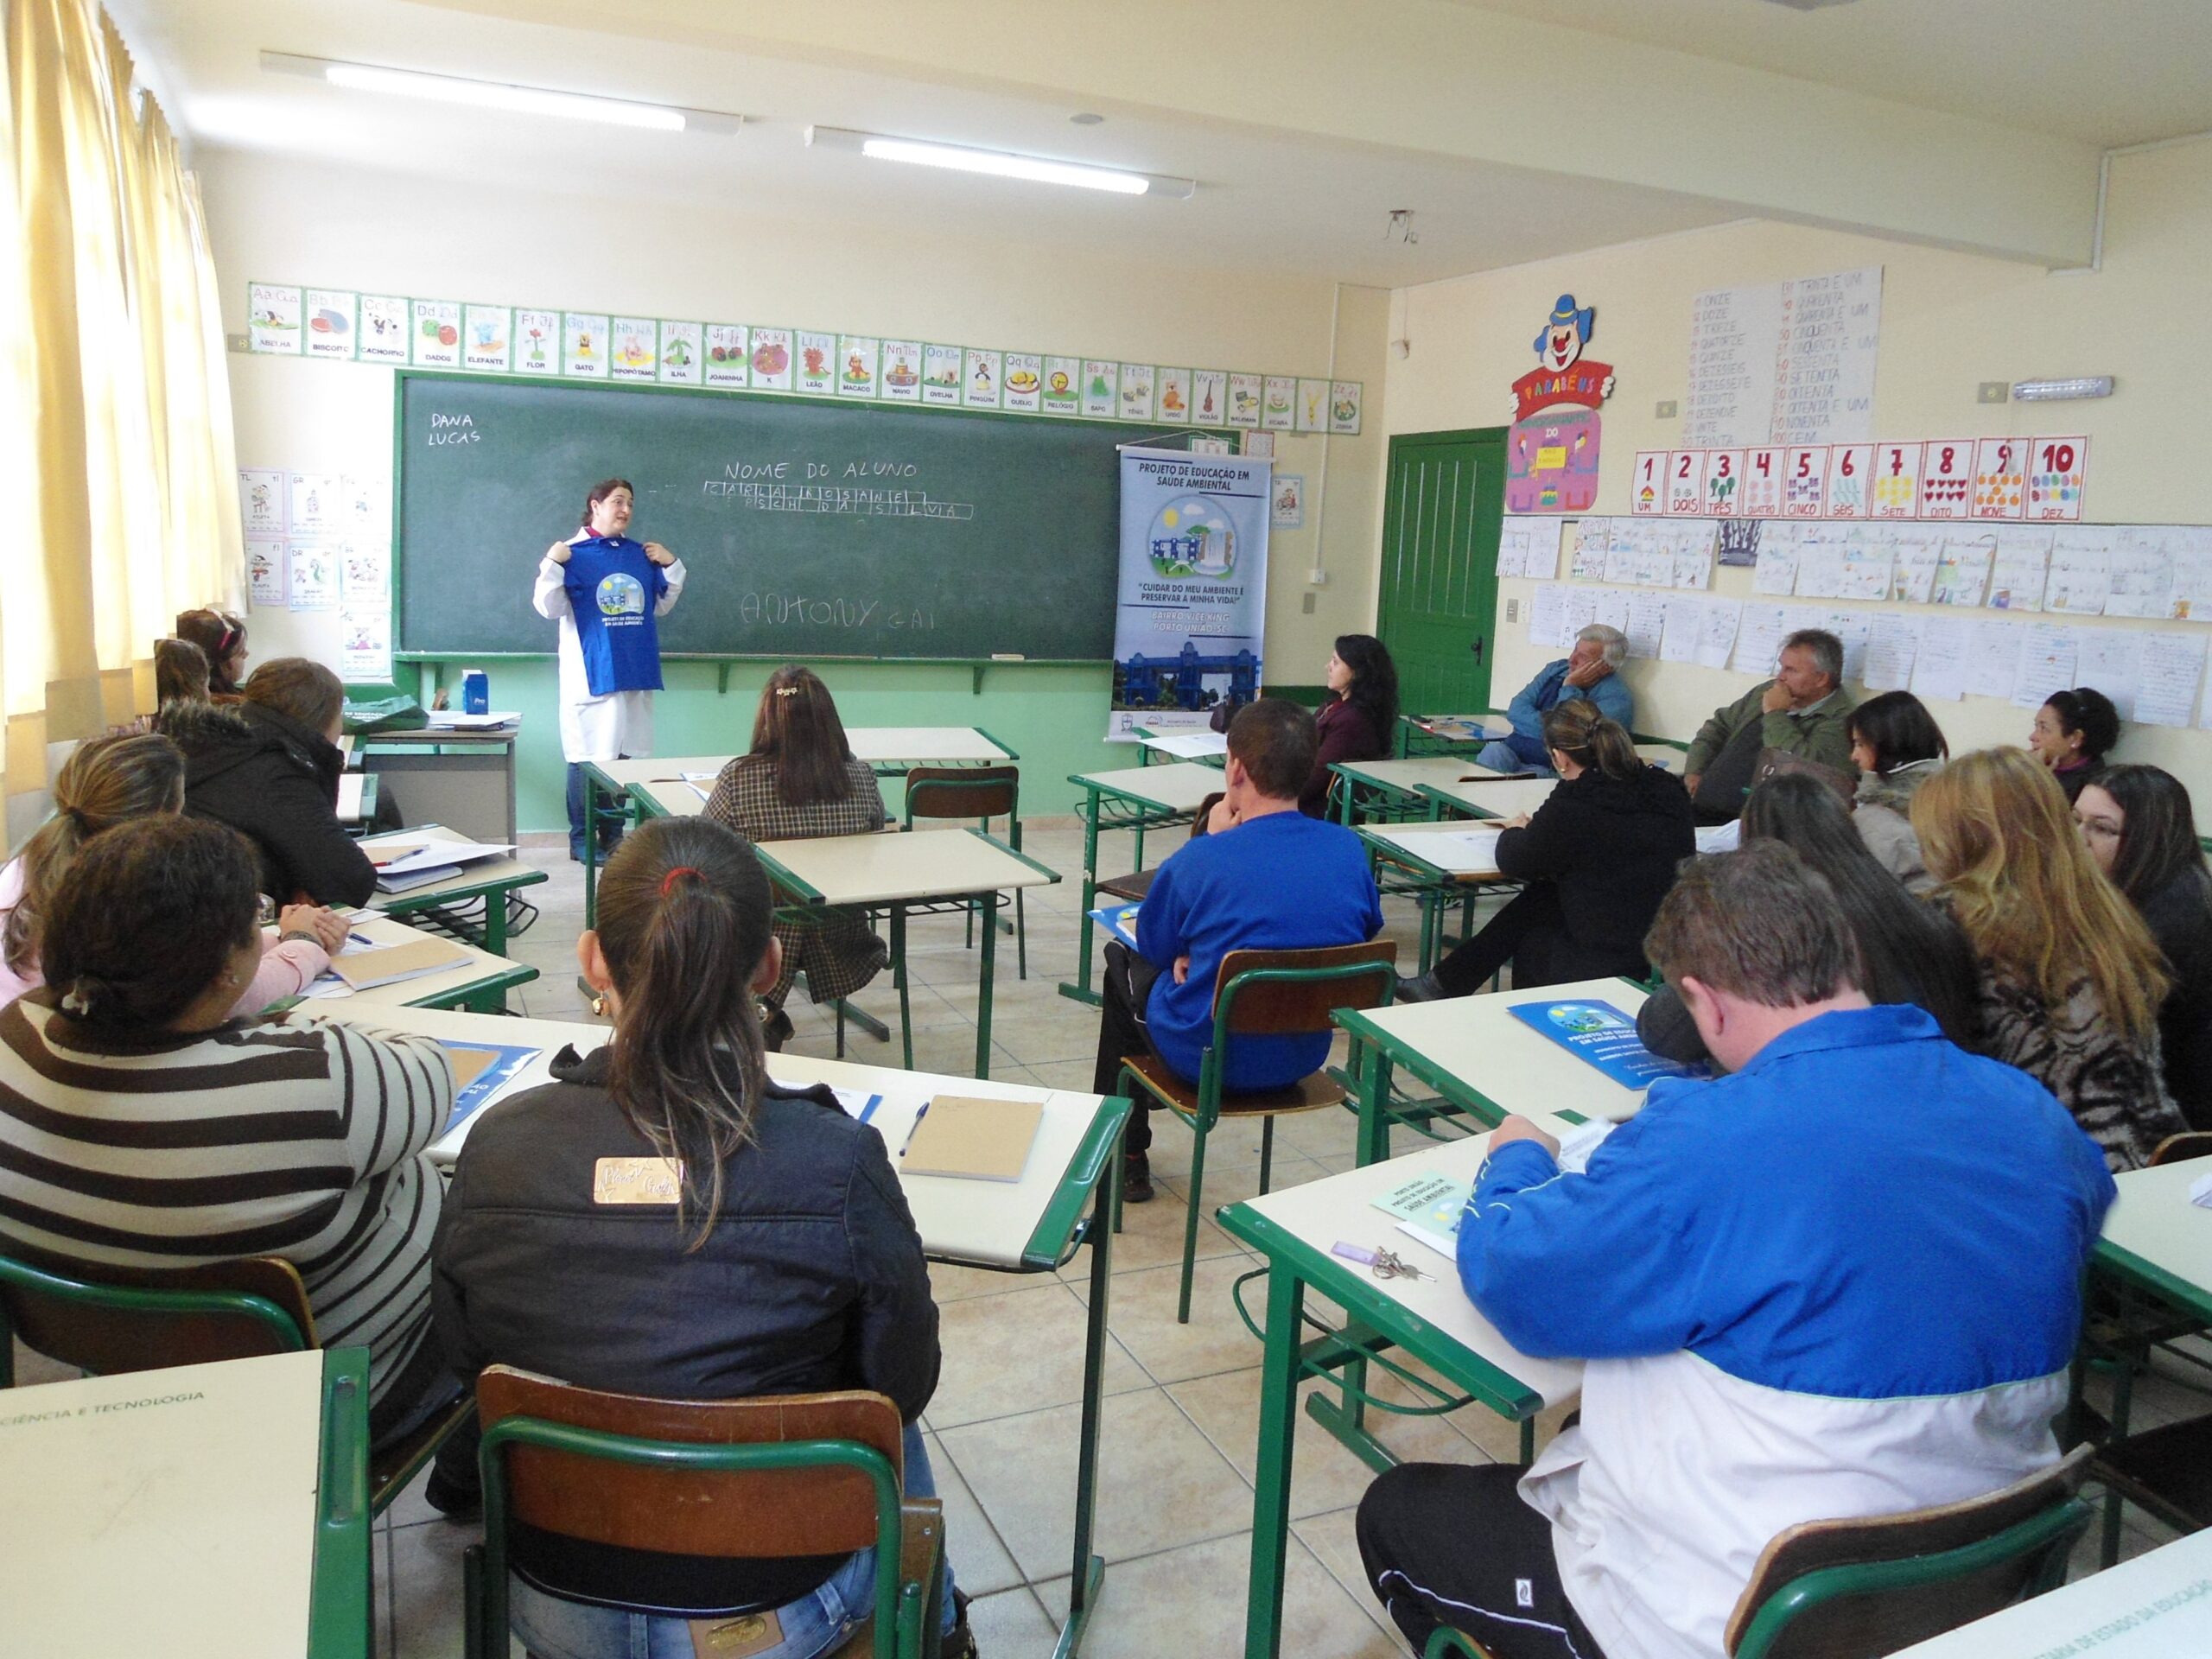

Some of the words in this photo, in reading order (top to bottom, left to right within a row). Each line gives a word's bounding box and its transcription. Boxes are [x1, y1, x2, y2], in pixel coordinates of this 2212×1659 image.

[417, 305, 435, 316] Dd
[754, 330, 769, 341] Kk
[259, 339, 291, 347] ABELHA
[359, 346, 405, 357] CACHORRO
[887, 345, 902, 355] Nn
[926, 346, 942, 359] Oo
[467, 355, 505, 365] ELEFANTE
[968, 352, 982, 364] Pp
[1007, 355, 1021, 369] Qq
[1086, 363, 1100, 372] Ss
[1196, 373, 1208, 383] Vv
[1266, 378, 1278, 388] Xx
[1525, 368, 1595, 400] PARABÉNS
[432, 413, 473, 429] DANA
[429, 430, 480, 446] LUCAS
[1546, 428, 1558, 438] DO
[1841, 449, 1854, 477] 6
[1891, 448, 1903, 476] 7
[1940, 447, 1955, 474] 8
[1997, 444, 2012, 474] 9
[2043, 444, 2074, 473] 10
[725, 462, 790, 479] NOME
[808, 463, 830, 477] DO
[842, 463, 917, 478] ALUNO
[1139, 463, 1176, 474] PROJETO
[1179, 466, 1189, 475] DE
[1192, 467, 1236, 480] EDUCAÇÃO
[1238, 470, 1249, 480] EM
[1643, 458, 1653, 481] 1
[1678, 454, 1691, 478] 2
[1718, 454, 1731, 478] 3
[1757, 453, 1770, 478] 4
[1796, 453, 1811, 478] 5
[1157, 476, 1184, 487] SAÚDE
[1185, 478, 1231, 491] AMBIENTAL
[876, 504, 954, 516] SILVA
[1638, 502, 1651, 512] UM
[1673, 499, 1699, 512] DOIS
[1748, 505, 1775, 514] QUATRO
[1788, 504, 1817, 516] CINCO
[1834, 504, 1853, 516] SEIS
[1880, 506, 1906, 517] SETE
[1931, 507, 1952, 518] OITO
[2042, 508, 2064, 519] DEZ
[1172, 584, 1184, 593] DO
[1185, 585, 1201, 594] MEU
[1203, 586, 1238, 595] AMBIENTE
[1141, 593, 1181, 602] PRESERVAR
[1190, 594, 1215, 603] MINHA
[741, 593, 878, 627] ANTONY
[1152, 612, 1183, 620] BAIRRO
[1154, 622, 1183, 632] PORTO
[79, 1407, 86, 1417] E
[94, 1392, 205, 1414] TECNOLOGIA
